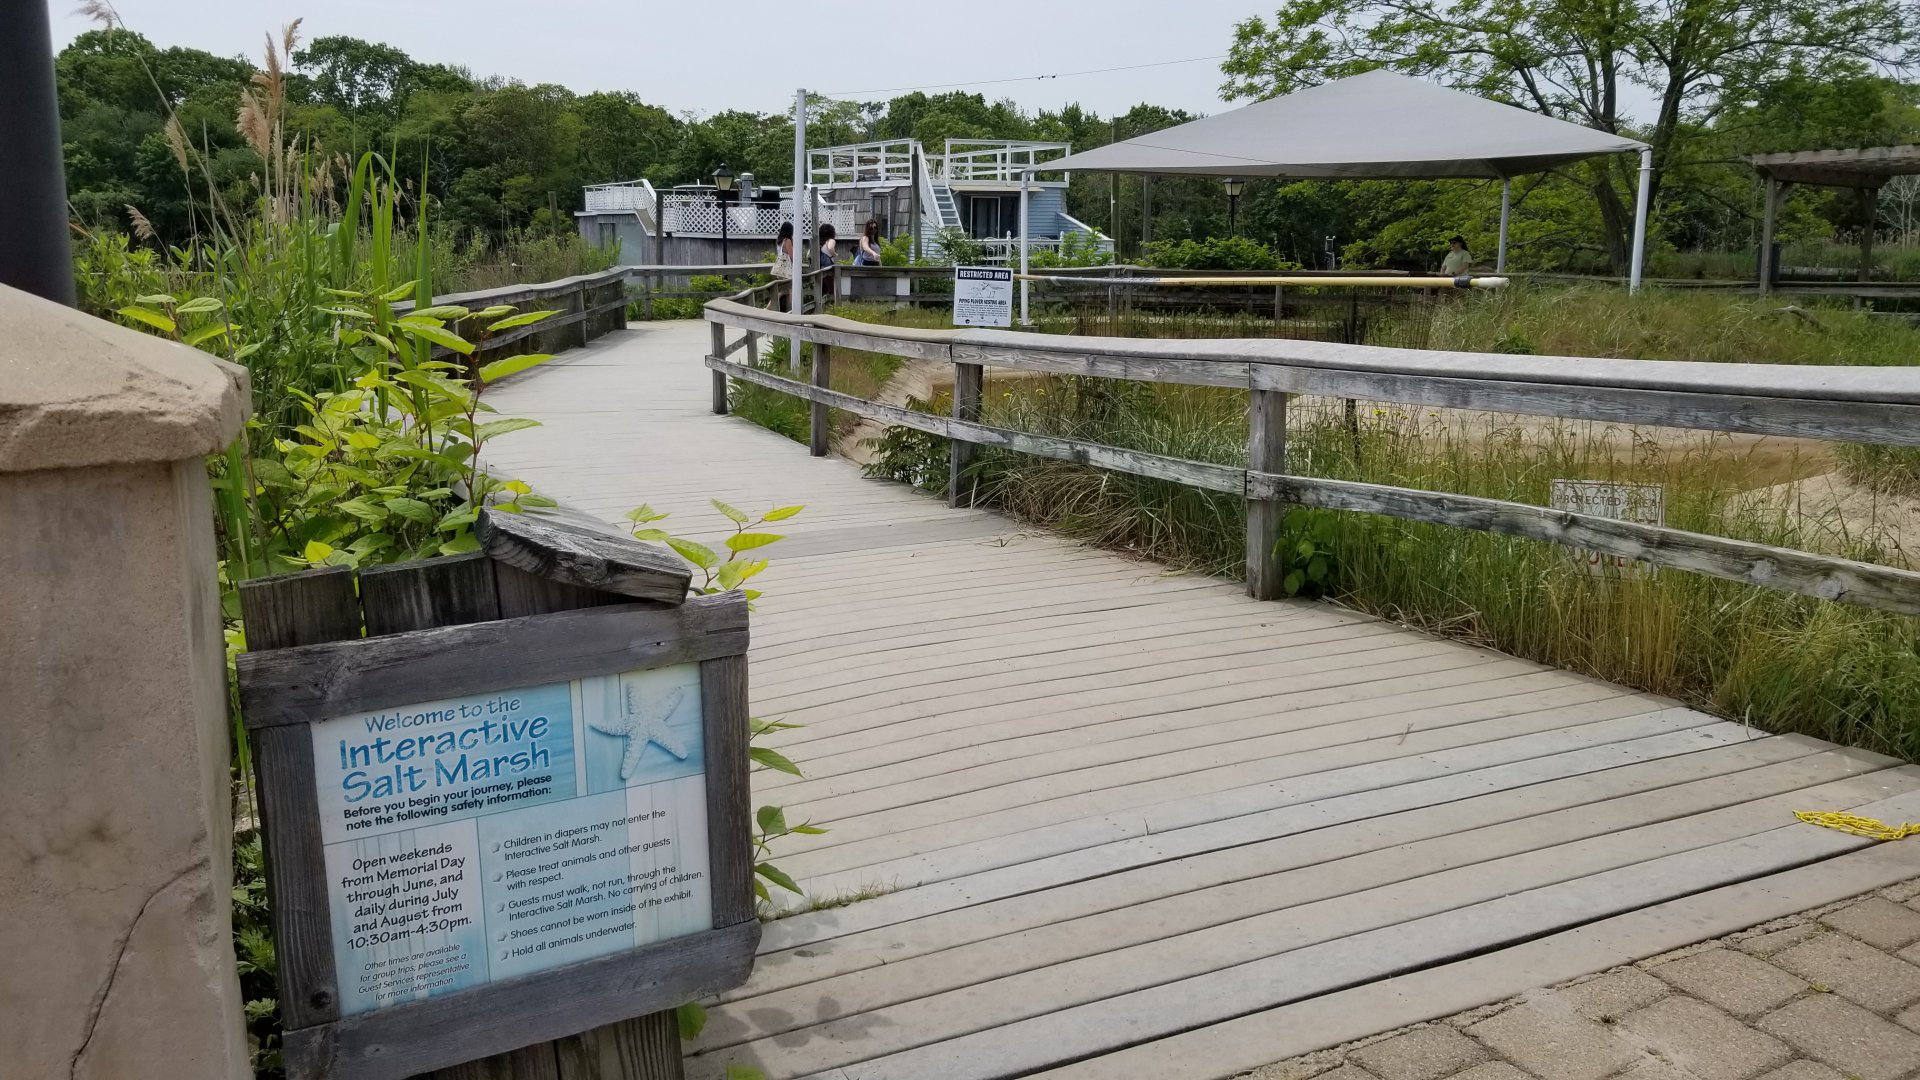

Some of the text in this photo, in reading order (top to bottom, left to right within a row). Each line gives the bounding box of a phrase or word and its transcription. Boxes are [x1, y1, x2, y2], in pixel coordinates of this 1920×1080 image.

[1556, 494, 1620, 506] PROTECTED
[364, 697, 520, 734] Welcome to the
[339, 715, 548, 769] Interactive
[342, 741, 550, 803] Salt Marsh
[344, 775, 552, 818] Before you begin your journey, please
[346, 786, 552, 831] note the following safety information:
[504, 810, 666, 849] Children in diapers may not enter the
[352, 843, 453, 872] Open weekends
[504, 834, 602, 861] Interactive Salt Marsh.
[506, 838, 671, 879] Please treat animals and other guests
[341, 857, 466, 888] from Memorial Day
[346, 870, 463, 903] through June, and
[507, 872, 564, 891] with respect.
[508, 866, 676, 909] Guests must walk, not run, through the
[354, 887, 459, 917] daily during July
[509, 871, 704, 921] Interactive Salt Marsh. No carrying of children.
[354, 904, 462, 934] and August from
[510, 890, 693, 939] Shoes cannot be worn inside of the exhibit.
[346, 916, 472, 950] 10:30am-4:30pm.
[512, 921, 637, 957] Hold all animals underwater.
[360, 974, 371, 983] for
[372, 968, 396, 980] group
[418, 958, 443, 972] please
[445, 955, 460, 963] see
[364, 960, 386, 971] Other
[389, 955, 409, 966] times
[426, 943, 460, 958] available
[359, 963, 470, 993] Guest Services representative
[375, 992, 386, 1001] for
[388, 988, 408, 997] more
